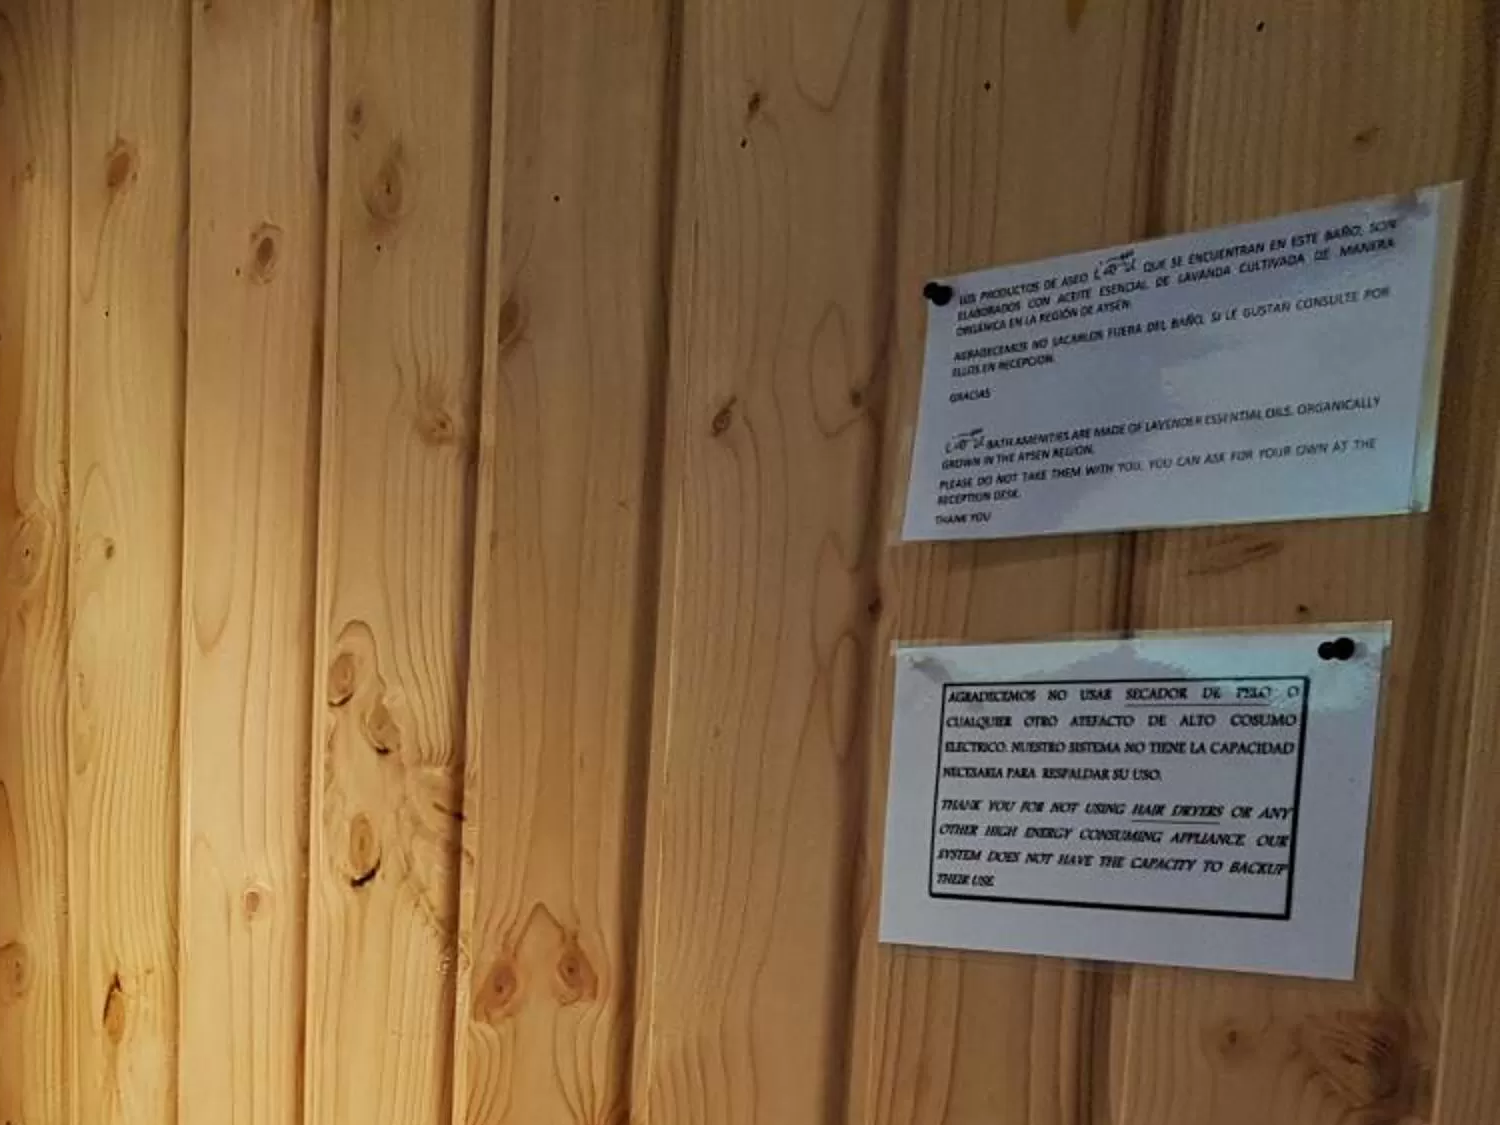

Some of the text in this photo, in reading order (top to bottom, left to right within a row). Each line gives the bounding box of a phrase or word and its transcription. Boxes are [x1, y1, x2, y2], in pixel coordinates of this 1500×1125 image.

[980, 281, 1039, 300] PRODUCTOS
[1044, 278, 1058, 291] DE
[1061, 272, 1088, 287] ASEO
[1143, 259, 1166, 273] QUE
[1170, 255, 1188, 269] SE
[1188, 241, 1265, 265] ENCUENTRAN
[1269, 238, 1287, 252] EN
[1291, 232, 1318, 248] ESTE
[1369, 217, 1398, 234] SON
[957, 237, 1396, 321] ELABORADOS CON ACEITE ESENCIAL DE LAVANDA CULTIVADA DE MANERA
[953, 340, 1028, 362] AGRADECEMOS
[1032, 338, 1048, 350] NO
[1107, 322, 1142, 339] FUERA
[1147, 320, 1167, 333] DEL
[1210, 309, 1221, 323] SI
[1225, 307, 1238, 321] LE
[1242, 301, 1290, 319] GUSTAN
[1295, 290, 1358, 311] CONSULTE
[1362, 286, 1390, 301] POR
[1009, 315, 1022, 328] EN
[1025, 313, 1037, 326] LA
[1080, 304, 1093, 317] DE
[982, 359, 995, 373] EN
[948, 387, 991, 403] GRACIAS
[986, 437, 1013, 450] BATH
[1013, 430, 1070, 447] AMENITIES
[1071, 428, 1090, 441] ARE
[1093, 423, 1124, 438] MADE
[1127, 421, 1142, 434] OF
[1144, 415, 1202, 433] LAVENDER
[1204, 408, 1263, 425] ESSENTIAL
[1297, 395, 1380, 416] ORGANICALLY
[939, 476, 973, 490] PLEASE
[977, 474, 993, 486] DO
[995, 472, 1018, 485] NOT
[1022, 470, 1047, 483] TAKE
[1051, 466, 1081, 479] THEM
[1085, 463, 1114, 477] WITH
[1149, 458, 1173, 470] YOU
[1176, 454, 1200, 467] CAN
[1204, 452, 1225, 465] ASK
[1230, 449, 1253, 462] FOR
[1259, 445, 1291, 460] YOUR
[1295, 442, 1329, 456] OWN
[1332, 439, 1349, 452] AT
[1353, 437, 1377, 450] THE
[941, 456, 981, 471] GROWN
[984, 454, 993, 466] IN
[995, 451, 1015, 464] THE
[936, 491, 991, 506] RECEPTION
[935, 511, 992, 525] THANK YOU
[948, 685, 1300, 703] AGRADECEMOS NO USAR SECADOR DE PELO O
[946, 713, 1297, 730] CUALQUIER OTRO ATEFACTO DE ALTO COSUMO
[1011, 741, 1067, 754] NUESTRO
[1067, 741, 1122, 754] SISTEMA
[1124, 741, 1146, 754] NO
[1150, 741, 1186, 755] TIENE
[1189, 741, 1206, 755] LA
[1209, 741, 1296, 755] CAPACIDAD
[942, 767, 1003, 779] NECESARIA
[1006, 767, 1036, 779] PARA
[1041, 767, 1110, 781] RESPALDAR
[1111, 768, 1130, 781] SU
[941, 799, 1294, 820] THANK YOU FOR NOT USING HAIR DRYERS OR ANY
[938, 823, 979, 837] OTHER
[984, 825, 1019, 838] HIGH
[1023, 826, 1074, 840] ENERGY
[1079, 828, 1163, 844] CONSUMING
[1255, 834, 1290, 848] OUR
[936, 849, 1290, 876] SYSTEM DOES NOT HAVE THE CAPACITY TO BACKUP
[936, 872, 970, 886] THEIR
